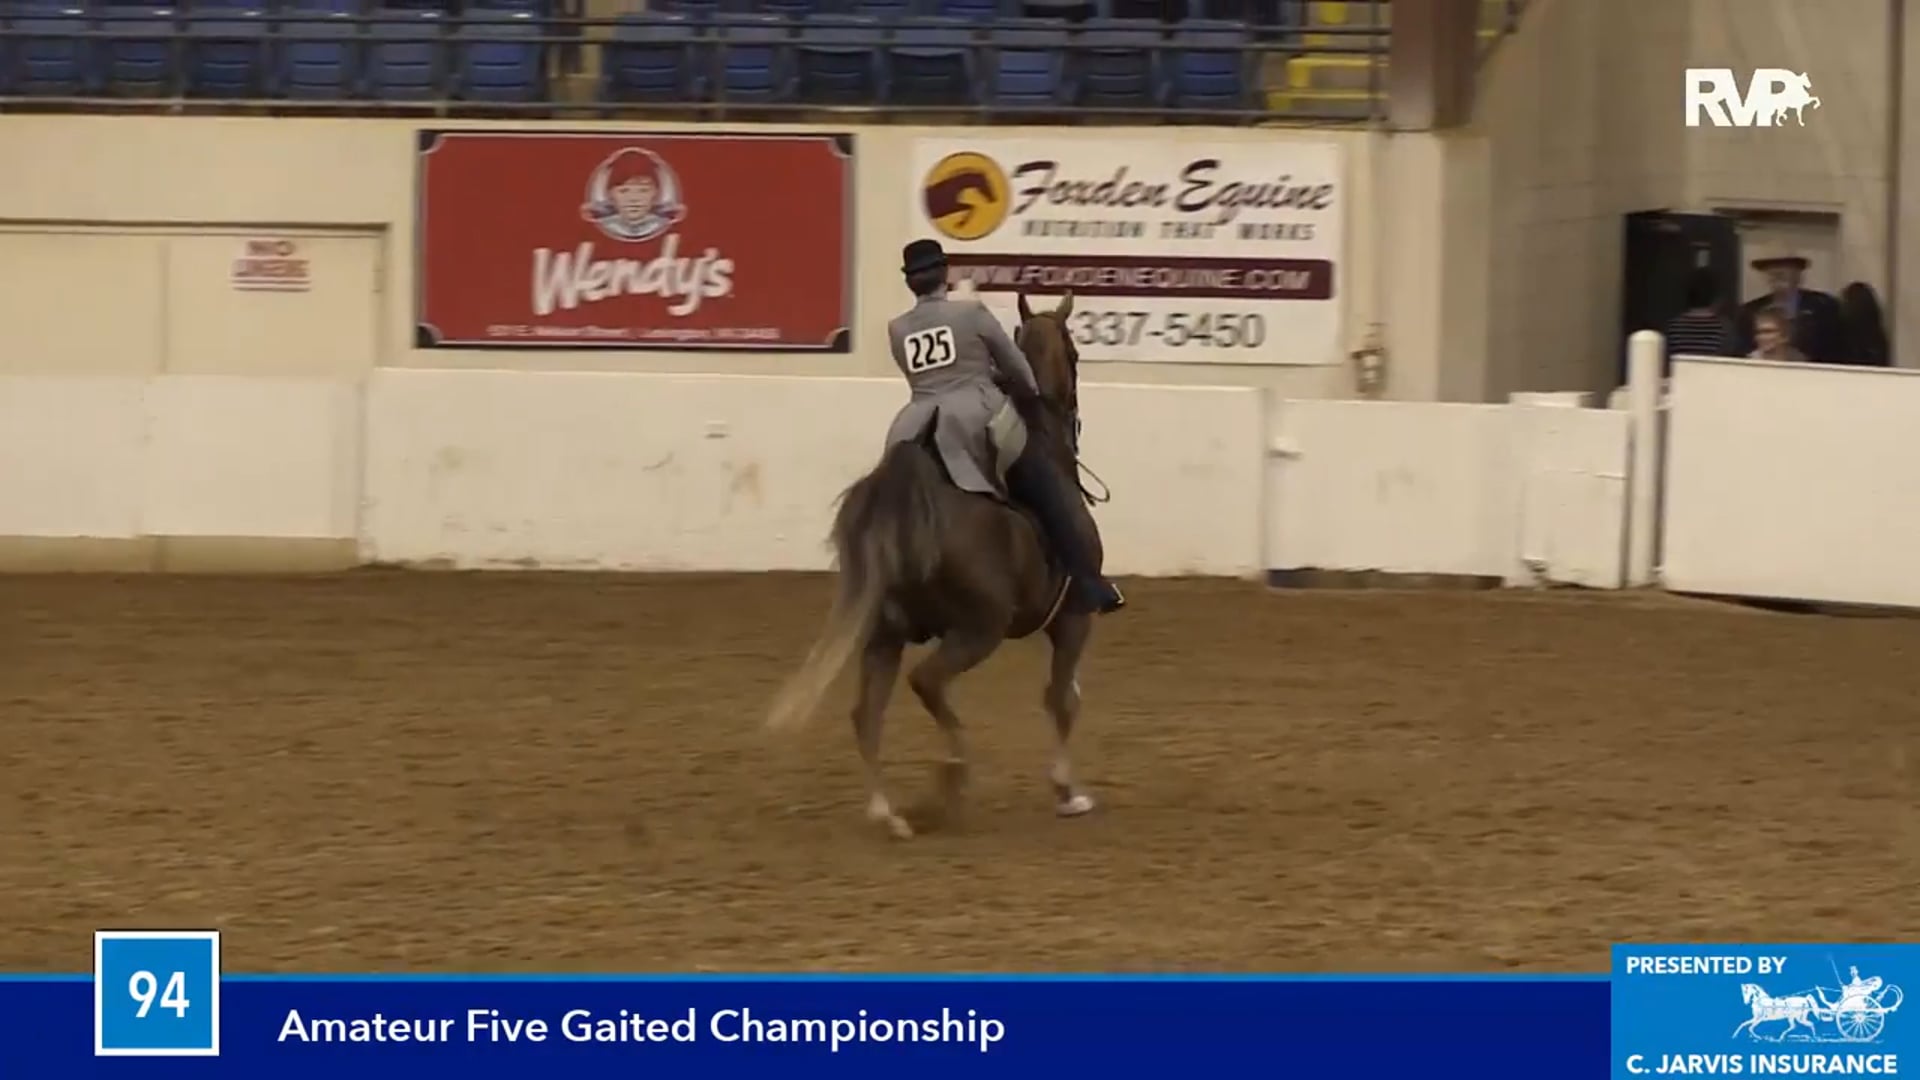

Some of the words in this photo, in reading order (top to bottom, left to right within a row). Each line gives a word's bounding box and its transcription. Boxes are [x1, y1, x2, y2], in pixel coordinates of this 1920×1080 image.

[1012, 160, 1169, 215] Foxden
[1173, 159, 1334, 226] Equine
[532, 233, 735, 316] Wendy's
[908, 329, 951, 369] 225
[1070, 311, 1267, 349] 337-5450
